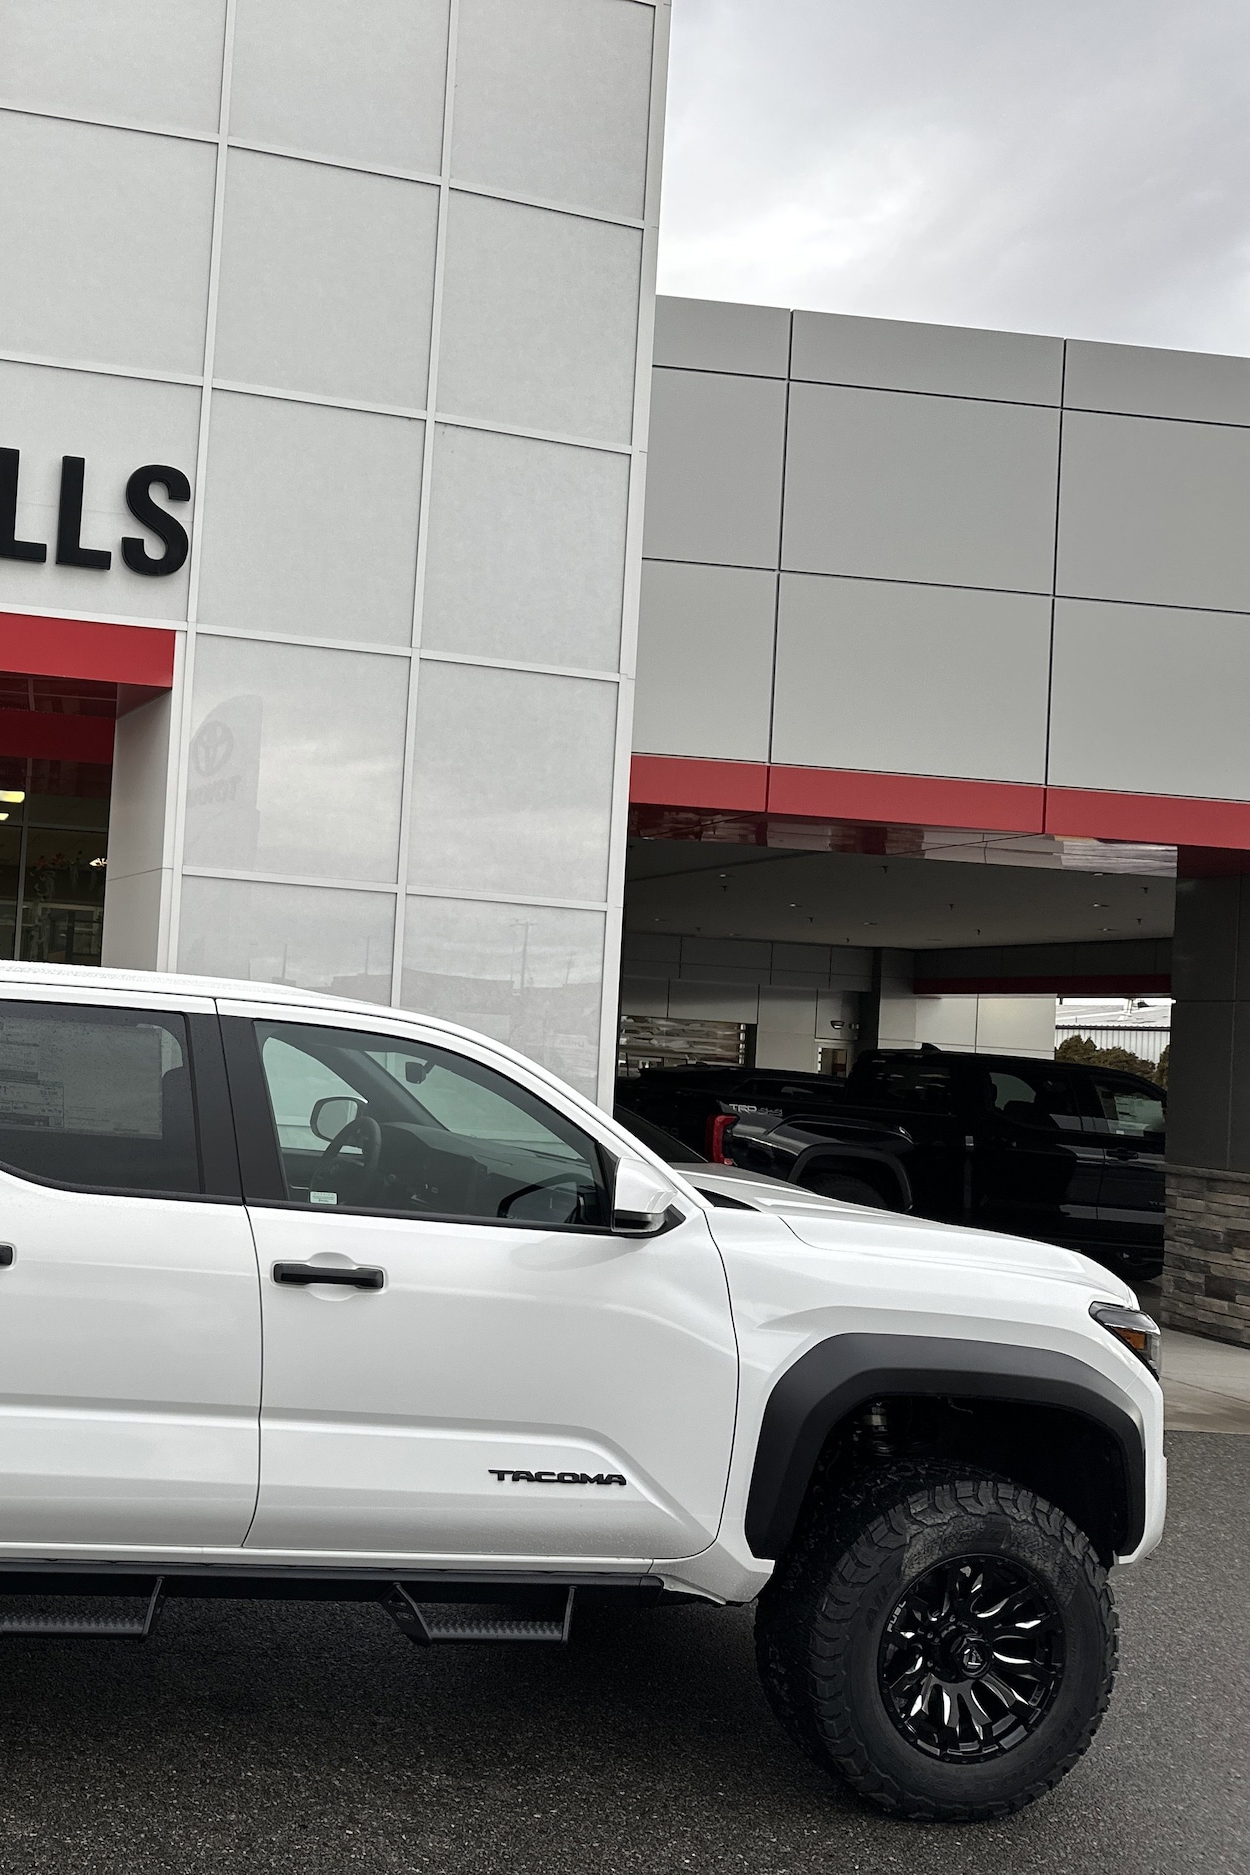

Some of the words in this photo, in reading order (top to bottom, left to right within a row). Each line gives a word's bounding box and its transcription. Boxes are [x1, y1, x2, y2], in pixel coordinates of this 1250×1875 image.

[728, 1103, 758, 1115] TRD
[488, 1469, 627, 1485] TACOMA
[887, 1601, 907, 1632] FUEL
